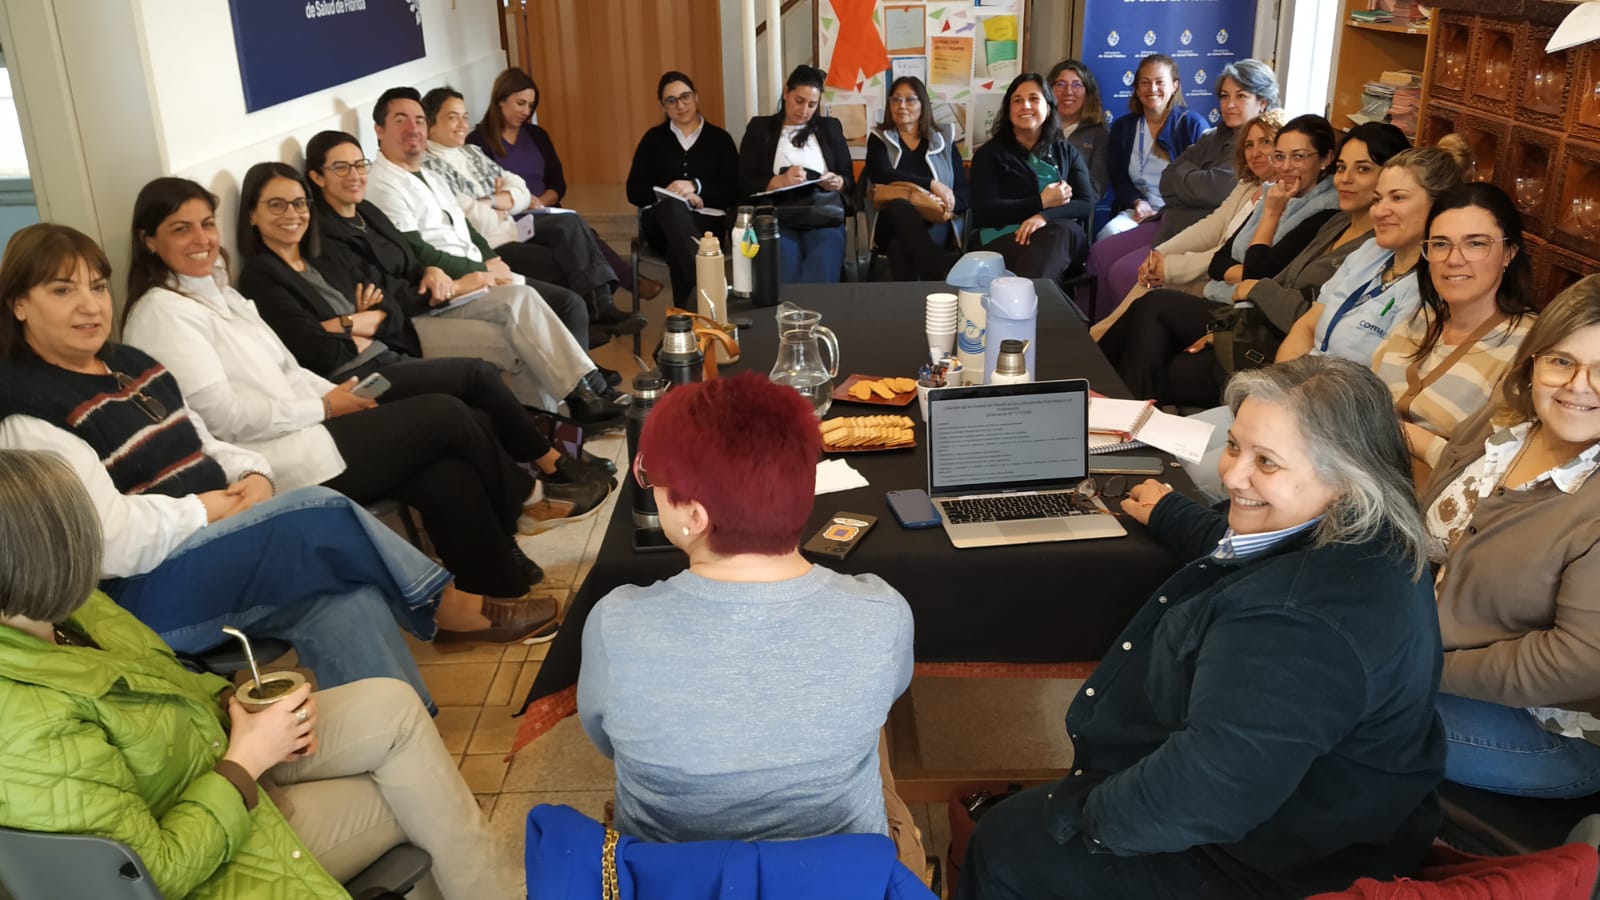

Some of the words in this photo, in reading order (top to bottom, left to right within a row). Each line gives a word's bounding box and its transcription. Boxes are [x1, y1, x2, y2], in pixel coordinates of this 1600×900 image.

[305, 2, 316, 19] de
[315, 0, 336, 17] Salud
[335, 0, 345, 14] de
